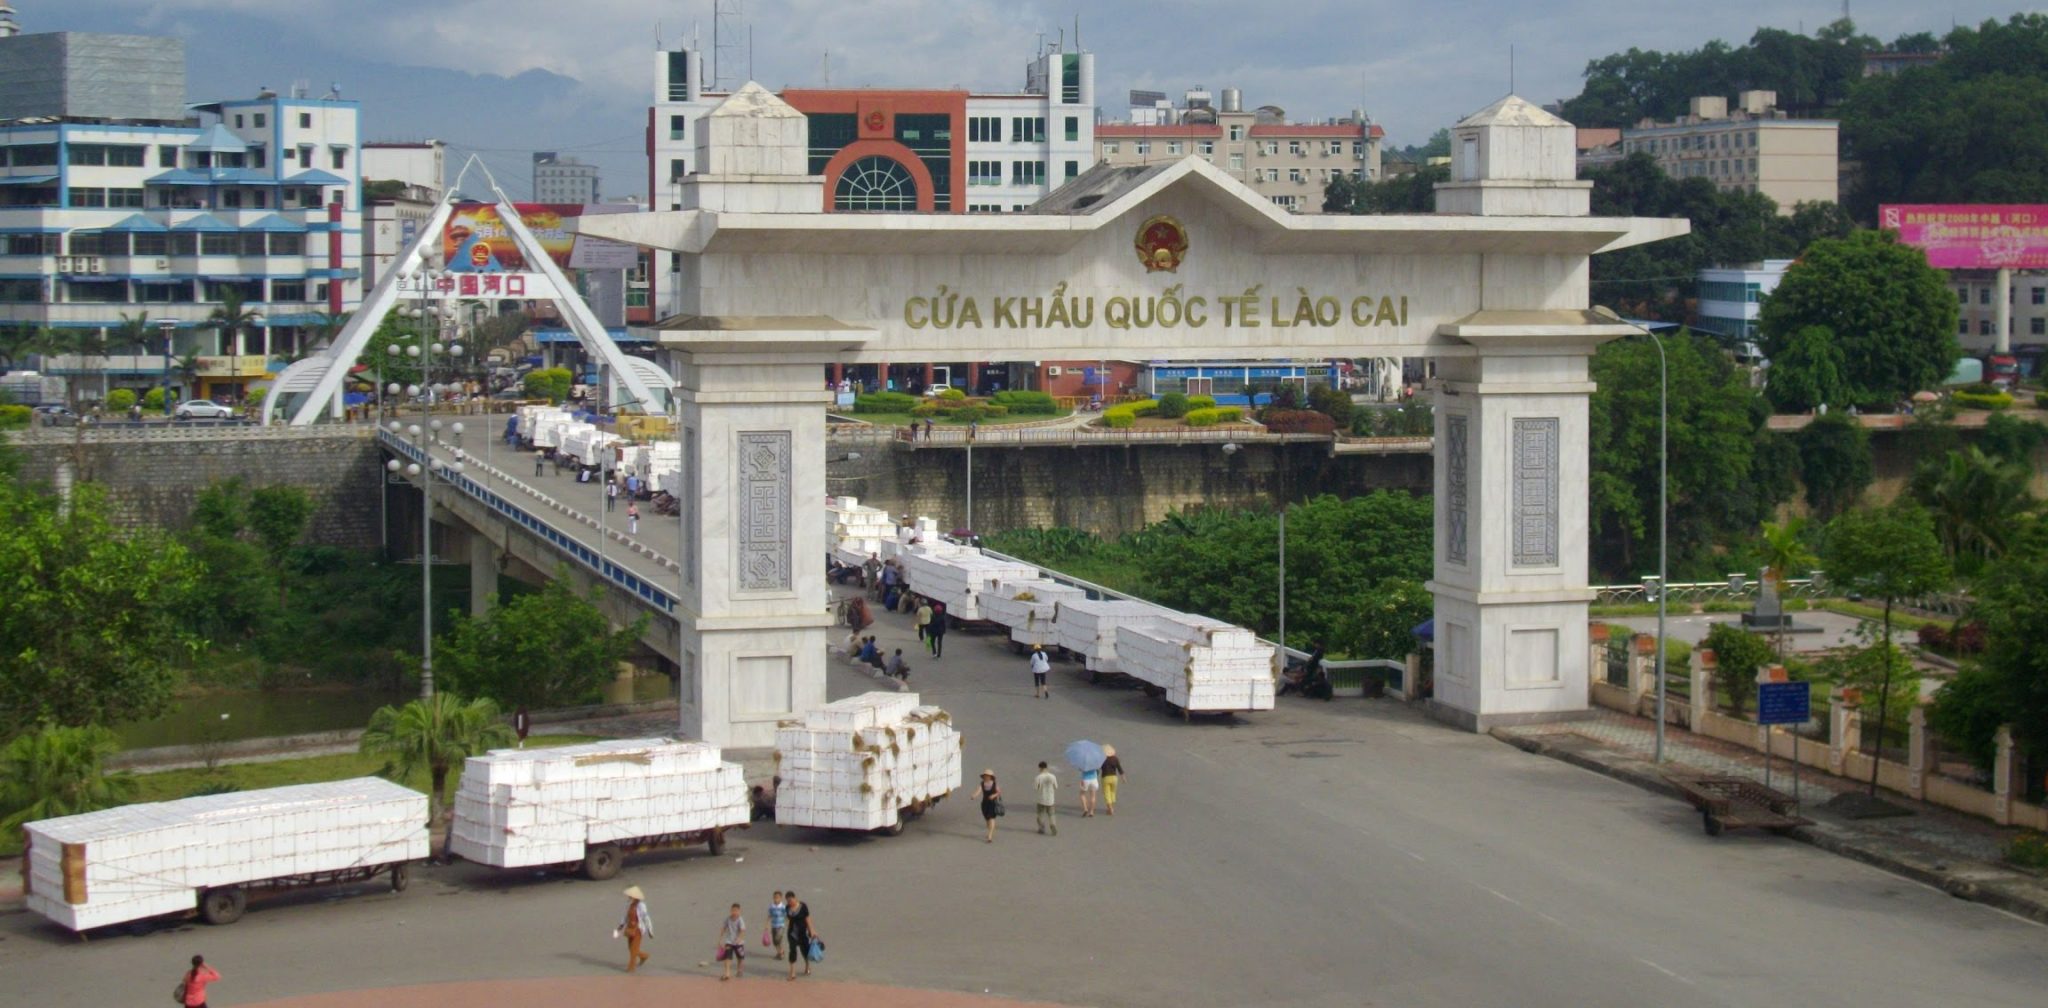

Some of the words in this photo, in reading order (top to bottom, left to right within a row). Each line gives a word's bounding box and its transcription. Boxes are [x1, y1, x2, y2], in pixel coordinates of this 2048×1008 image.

[436, 274, 525, 297] 中国河口
[905, 286, 982, 330] CỬA
[994, 281, 1095, 329] KHẨU
[1105, 285, 1208, 330] QUỐC
[1219, 284, 1262, 328] TẾ
[1272, 287, 1341, 328] LÀO
[1352, 296, 1409, 328] CAI
